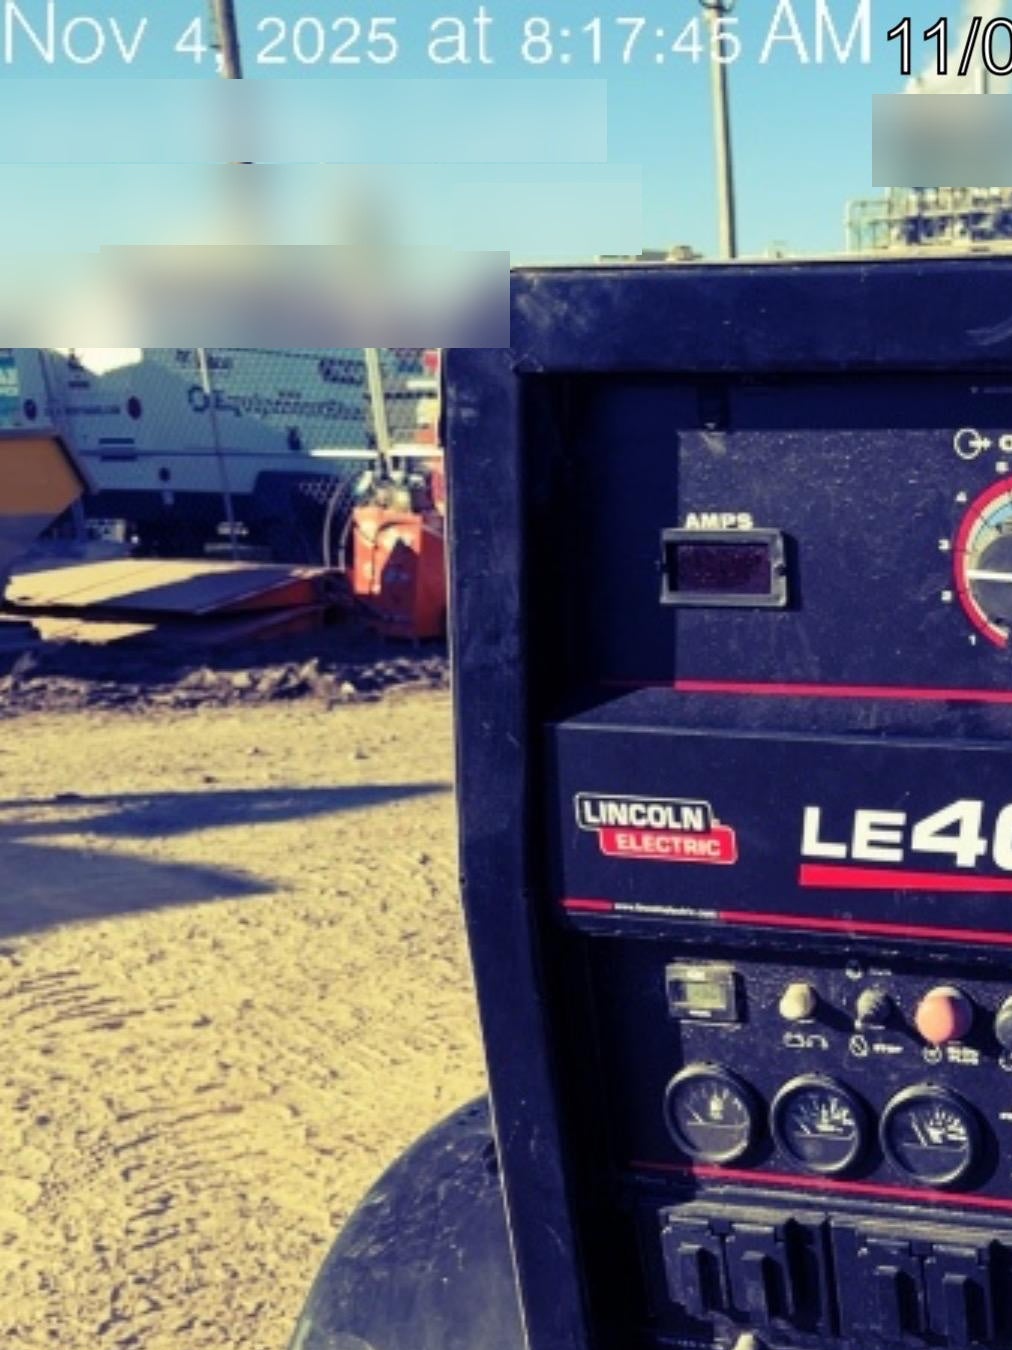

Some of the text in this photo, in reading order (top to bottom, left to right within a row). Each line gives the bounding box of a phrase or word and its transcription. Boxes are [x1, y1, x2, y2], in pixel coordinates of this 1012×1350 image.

[684, 512, 754, 530] AMPS
[583, 800, 705, 832] LINCOLN
[615, 833, 721, 857] ELECTRIC
